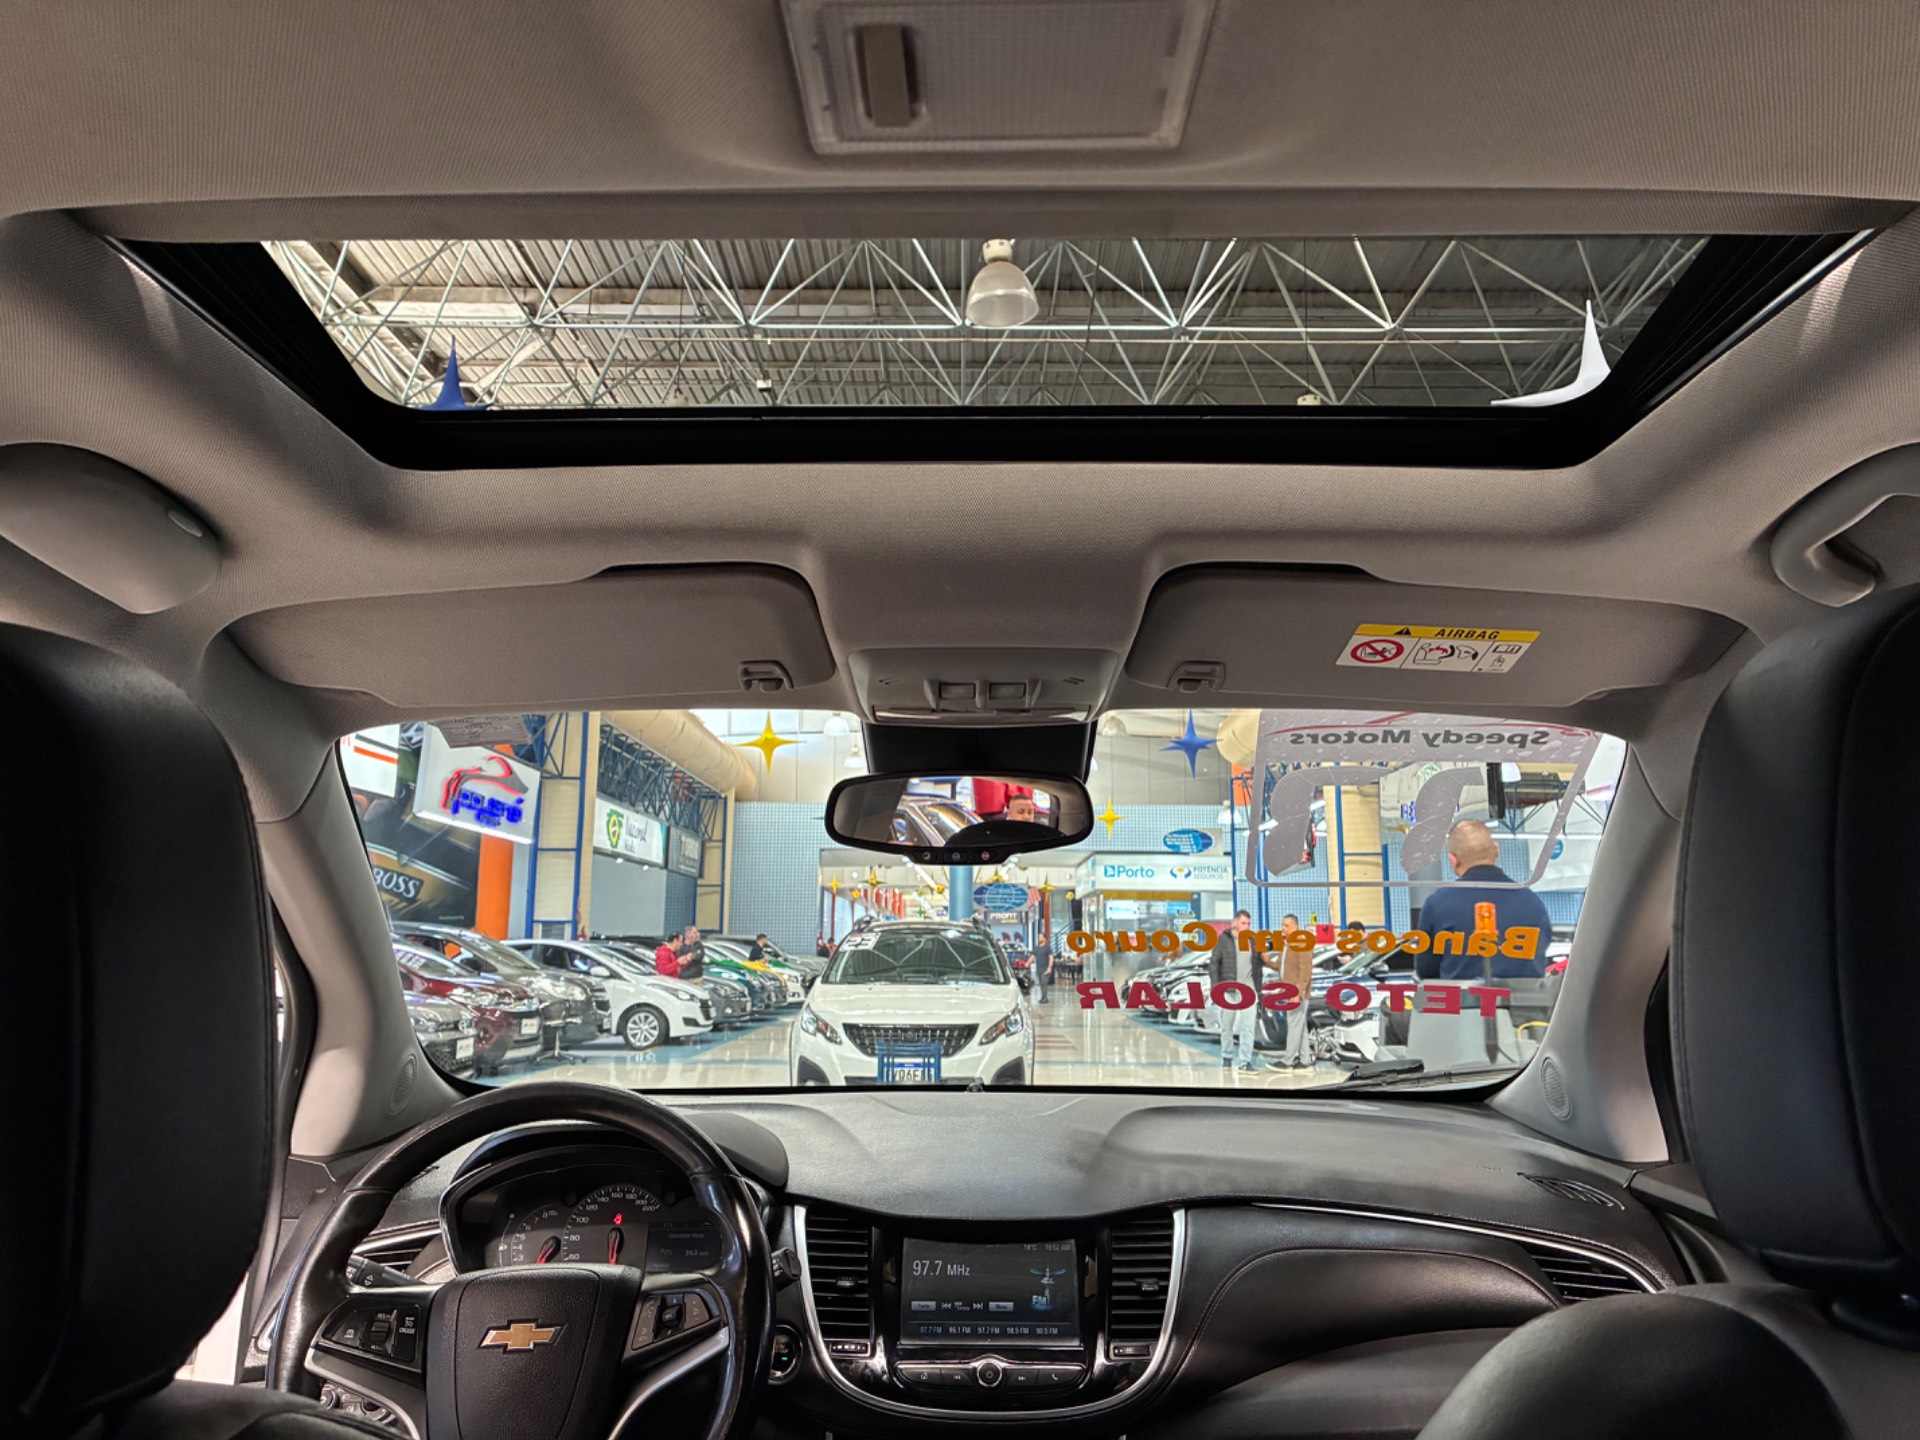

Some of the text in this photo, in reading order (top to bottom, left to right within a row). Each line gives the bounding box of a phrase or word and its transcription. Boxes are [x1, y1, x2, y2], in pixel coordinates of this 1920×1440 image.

[1434, 628, 1500, 640] AIRBAG
[1116, 865, 1155, 878] Porto
[912, 1260, 971, 1277] 97.7 MHz
[1031, 1295, 1047, 1305] FM
